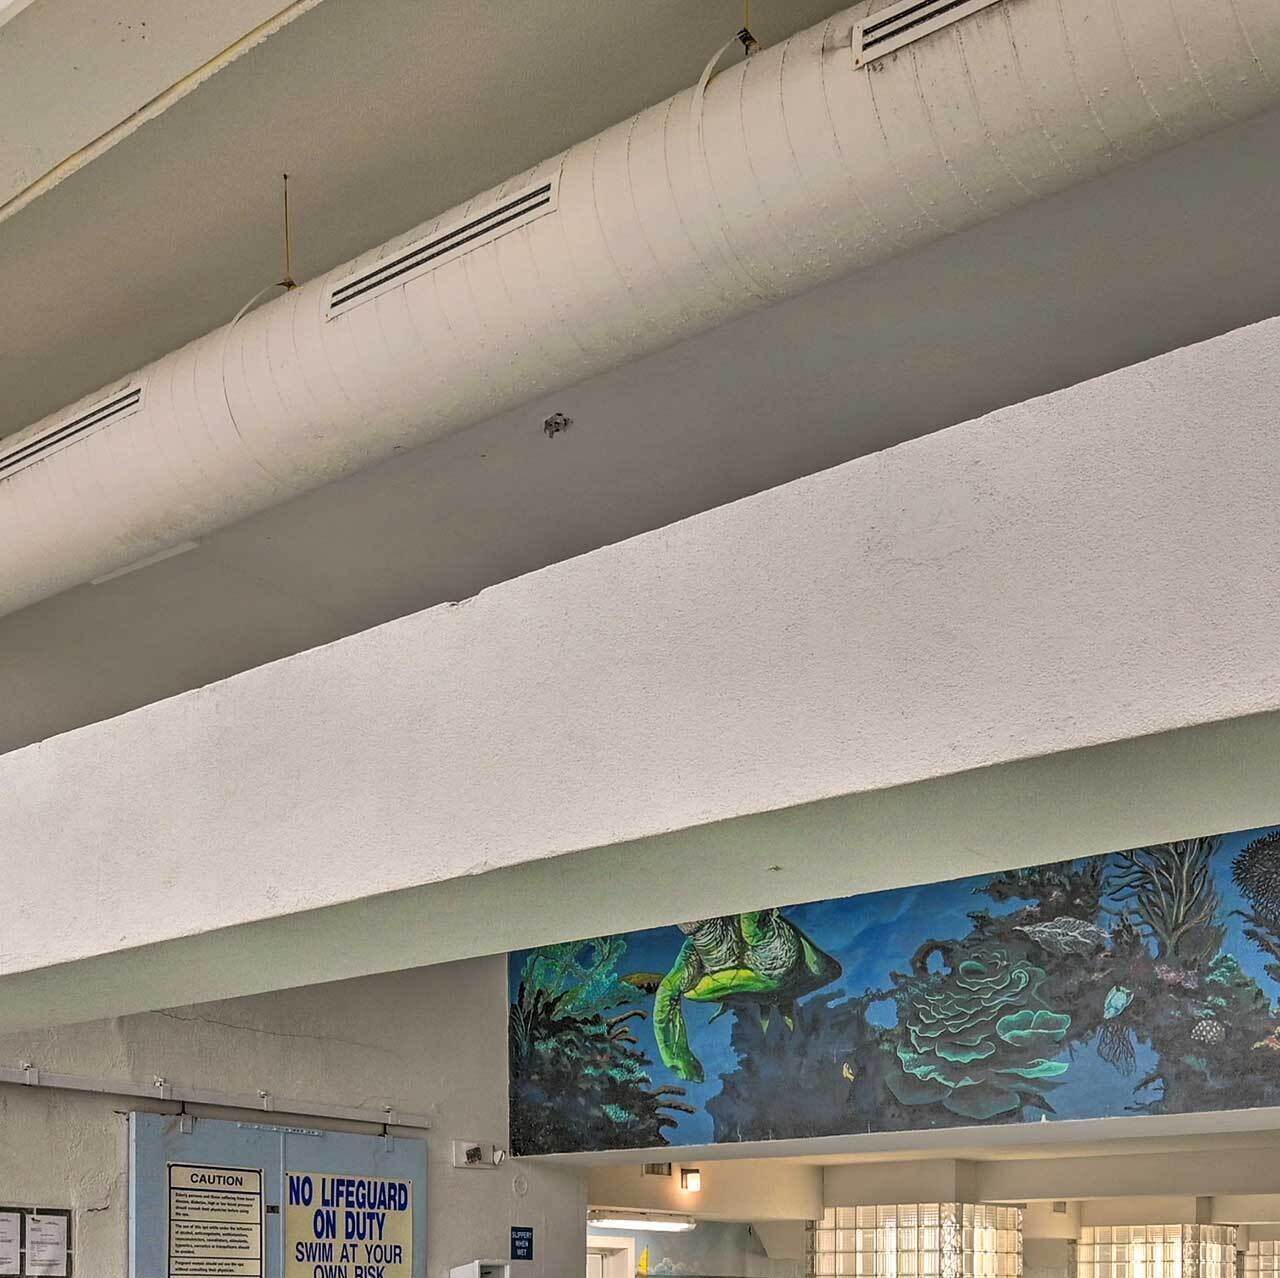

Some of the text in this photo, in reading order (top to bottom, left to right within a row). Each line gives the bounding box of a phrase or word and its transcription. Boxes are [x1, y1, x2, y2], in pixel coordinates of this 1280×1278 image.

[190, 1174, 243, 1186] CAUTION
[289, 1176, 408, 1211] NO LIFEGUARD
[314, 1209, 385, 1240] ON DUTY
[296, 1242, 402, 1264] SWIM AT YOUR
